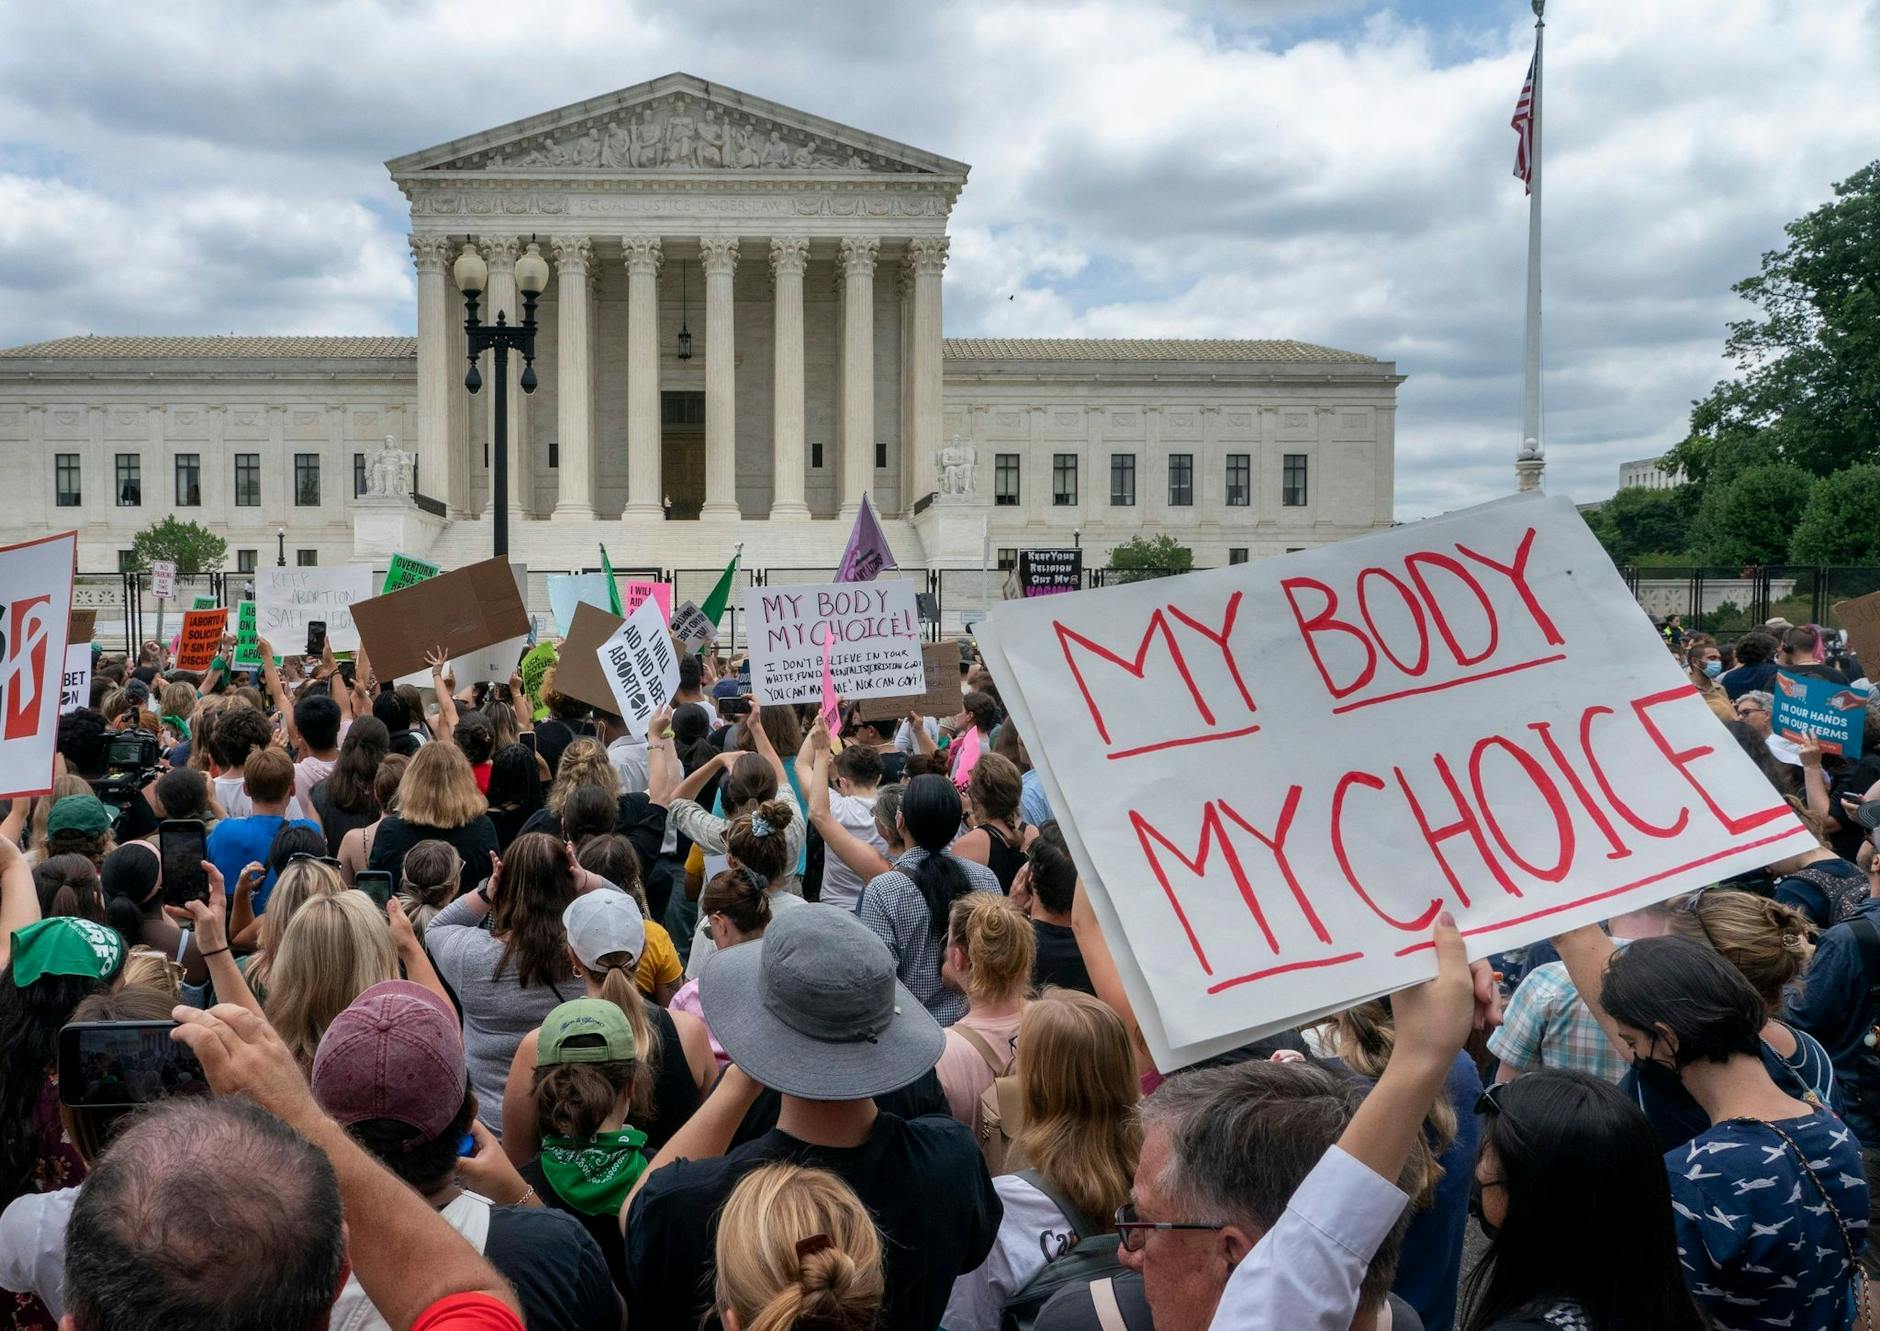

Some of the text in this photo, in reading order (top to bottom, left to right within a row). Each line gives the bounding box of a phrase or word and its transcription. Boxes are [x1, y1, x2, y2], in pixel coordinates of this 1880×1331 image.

[271, 571, 310, 588] KEEP
[396, 557, 434, 577] OVERTURN
[291, 590, 357, 605] ABORTION
[762, 589, 888, 623] MY BODY
[677, 626, 692, 642] ABE
[768, 623, 805, 652] MY
[1053, 527, 1565, 745] MY BODY
[623, 624, 643, 650] AID
[634, 646, 654, 677] AND
[649, 629, 670, 674] I WILL
[764, 649, 909, 672] I DON'T BLIEVE IN YOUR
[63, 671, 86, 687] BET
[856, 677, 874, 691] NOR
[876, 678, 895, 690] CAN
[1779, 714, 1790, 725] ON
[1790, 719, 1808, 732] OUR
[1810, 724, 1849, 740] TERMS
[1781, 702, 1848, 727] IN OUR HANDS
[1128, 683, 1792, 976] MY CHOICE
